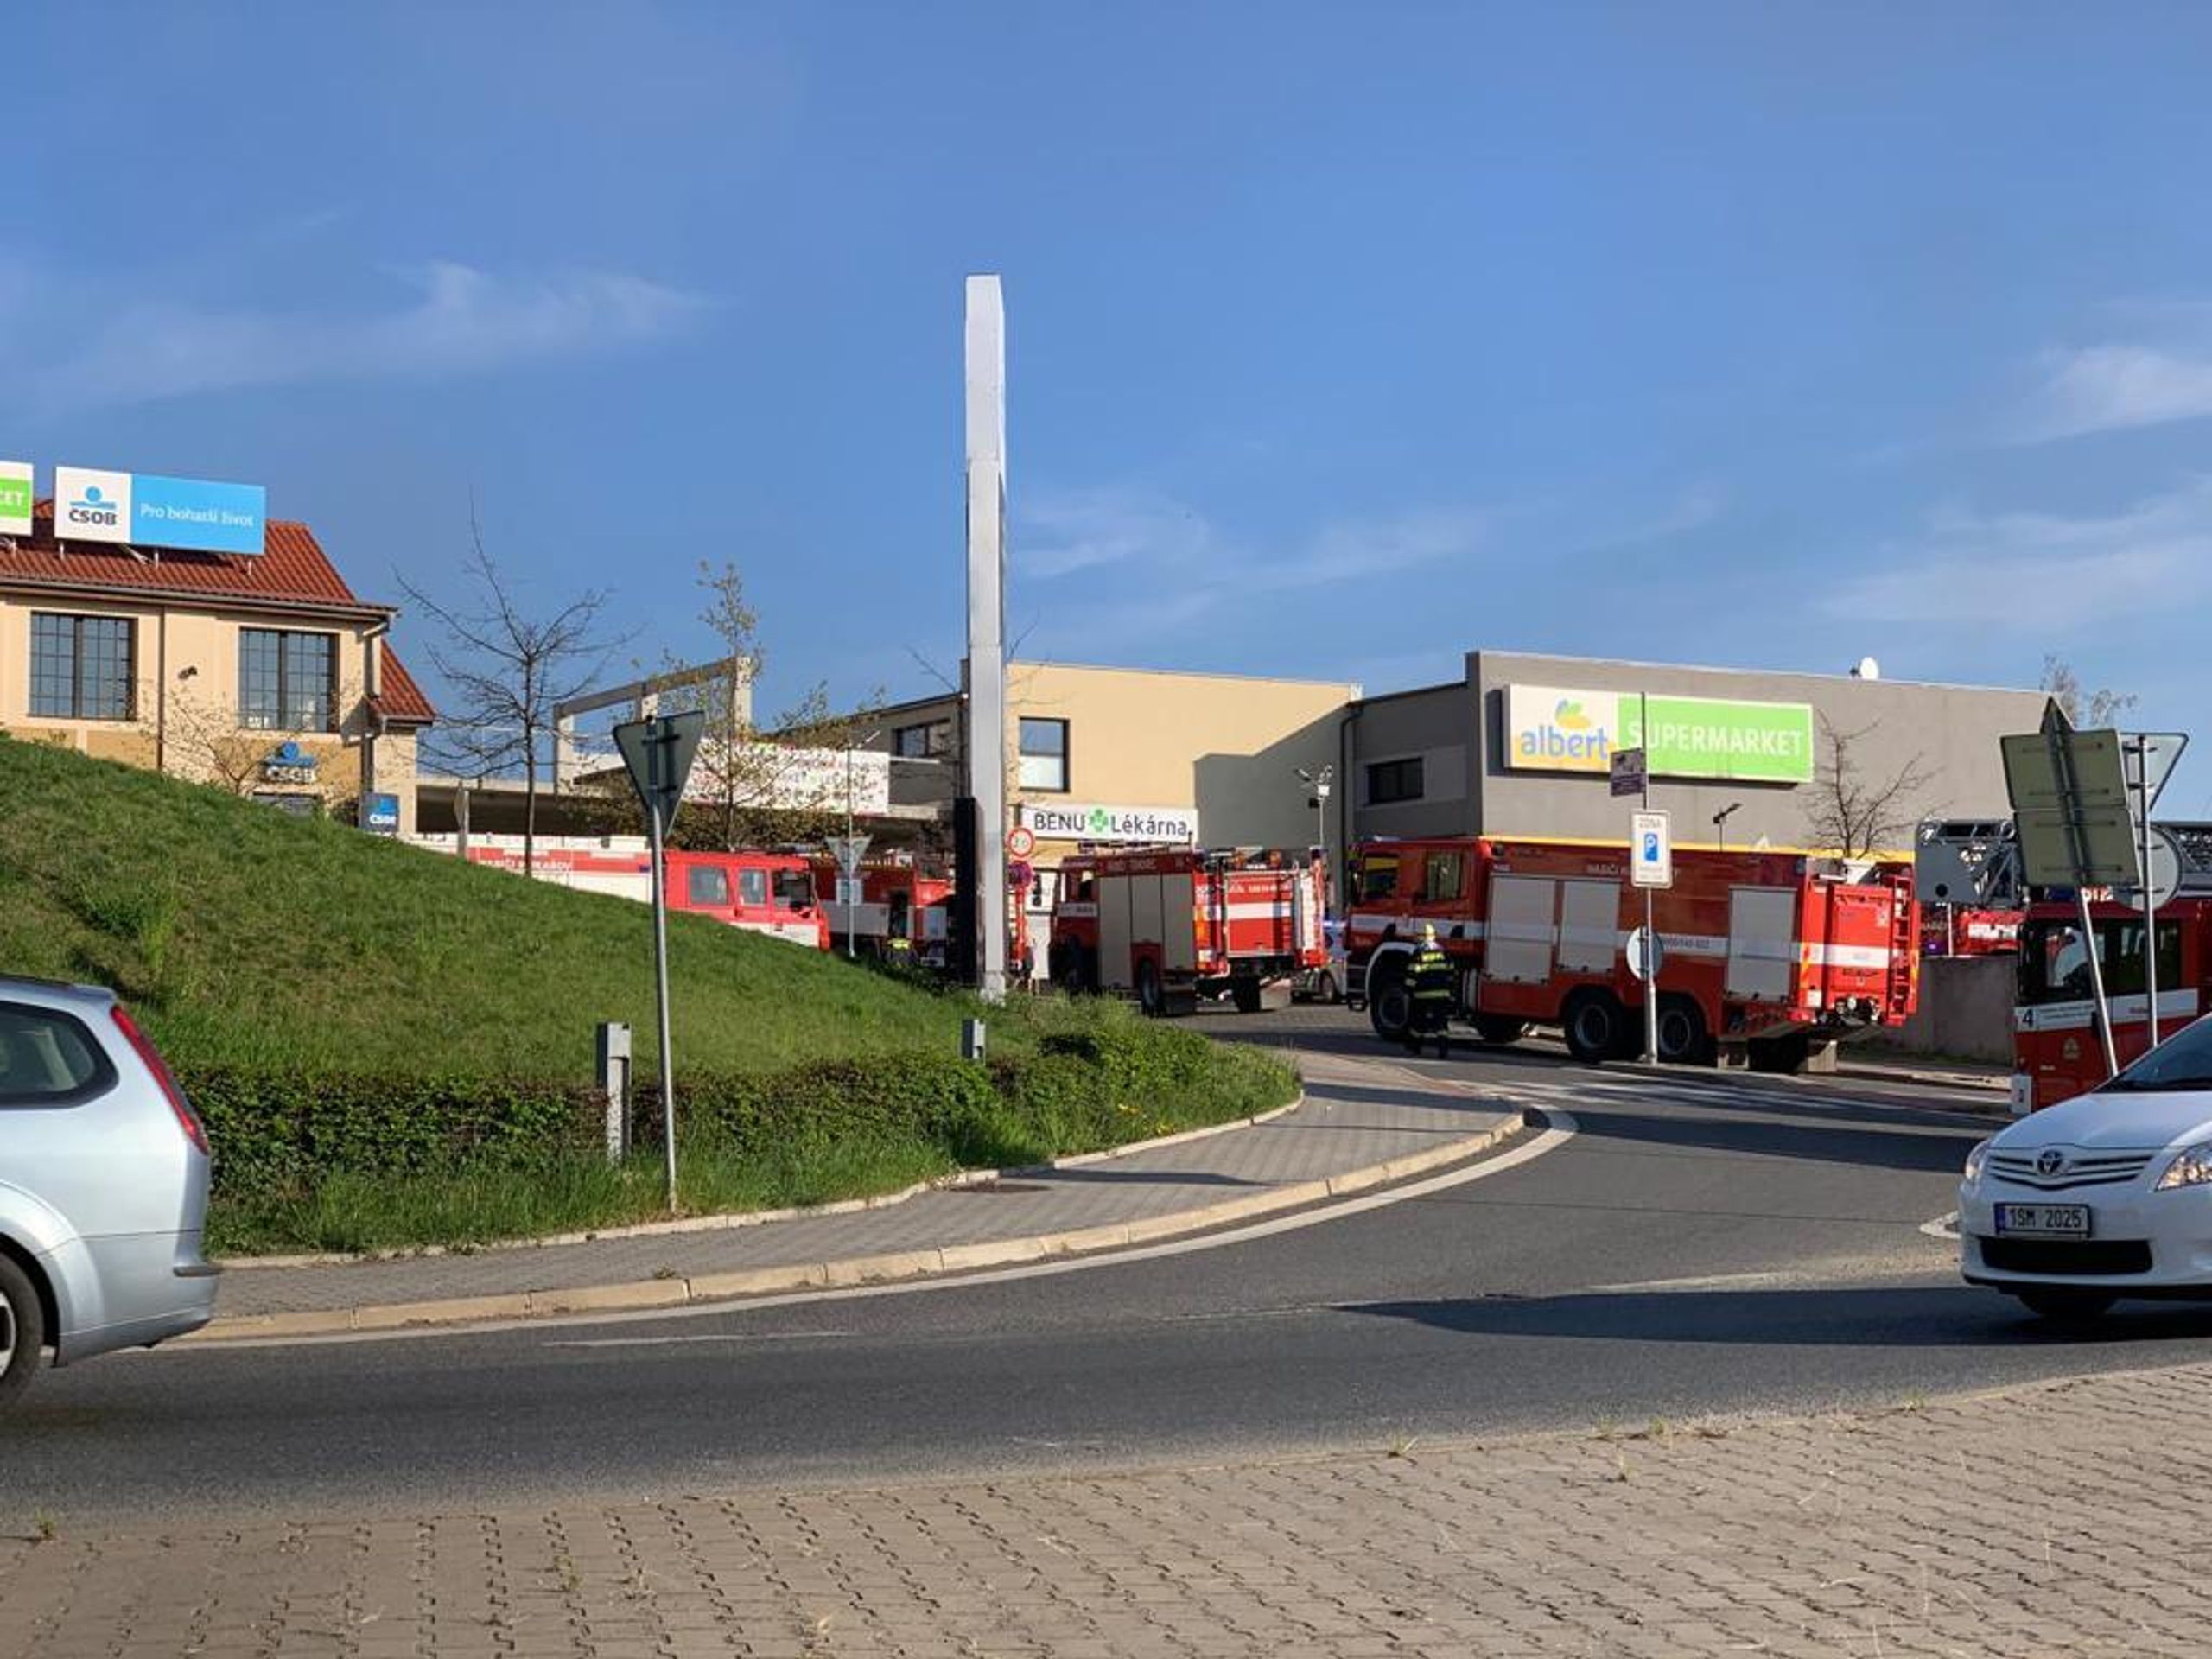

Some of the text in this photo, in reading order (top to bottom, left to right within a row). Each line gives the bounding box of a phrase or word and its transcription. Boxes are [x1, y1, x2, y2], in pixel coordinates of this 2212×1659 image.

[140, 502, 165, 518] Pro
[1521, 724, 1608, 760] albert
[1628, 721, 1803, 756] SUPERMARKET
[1034, 813, 1086, 832] BENU
[1110, 814, 1187, 836] Lékárna
[2022, 1008, 2034, 1027] 4
[2009, 1208, 2082, 1228] 1SM 2025
